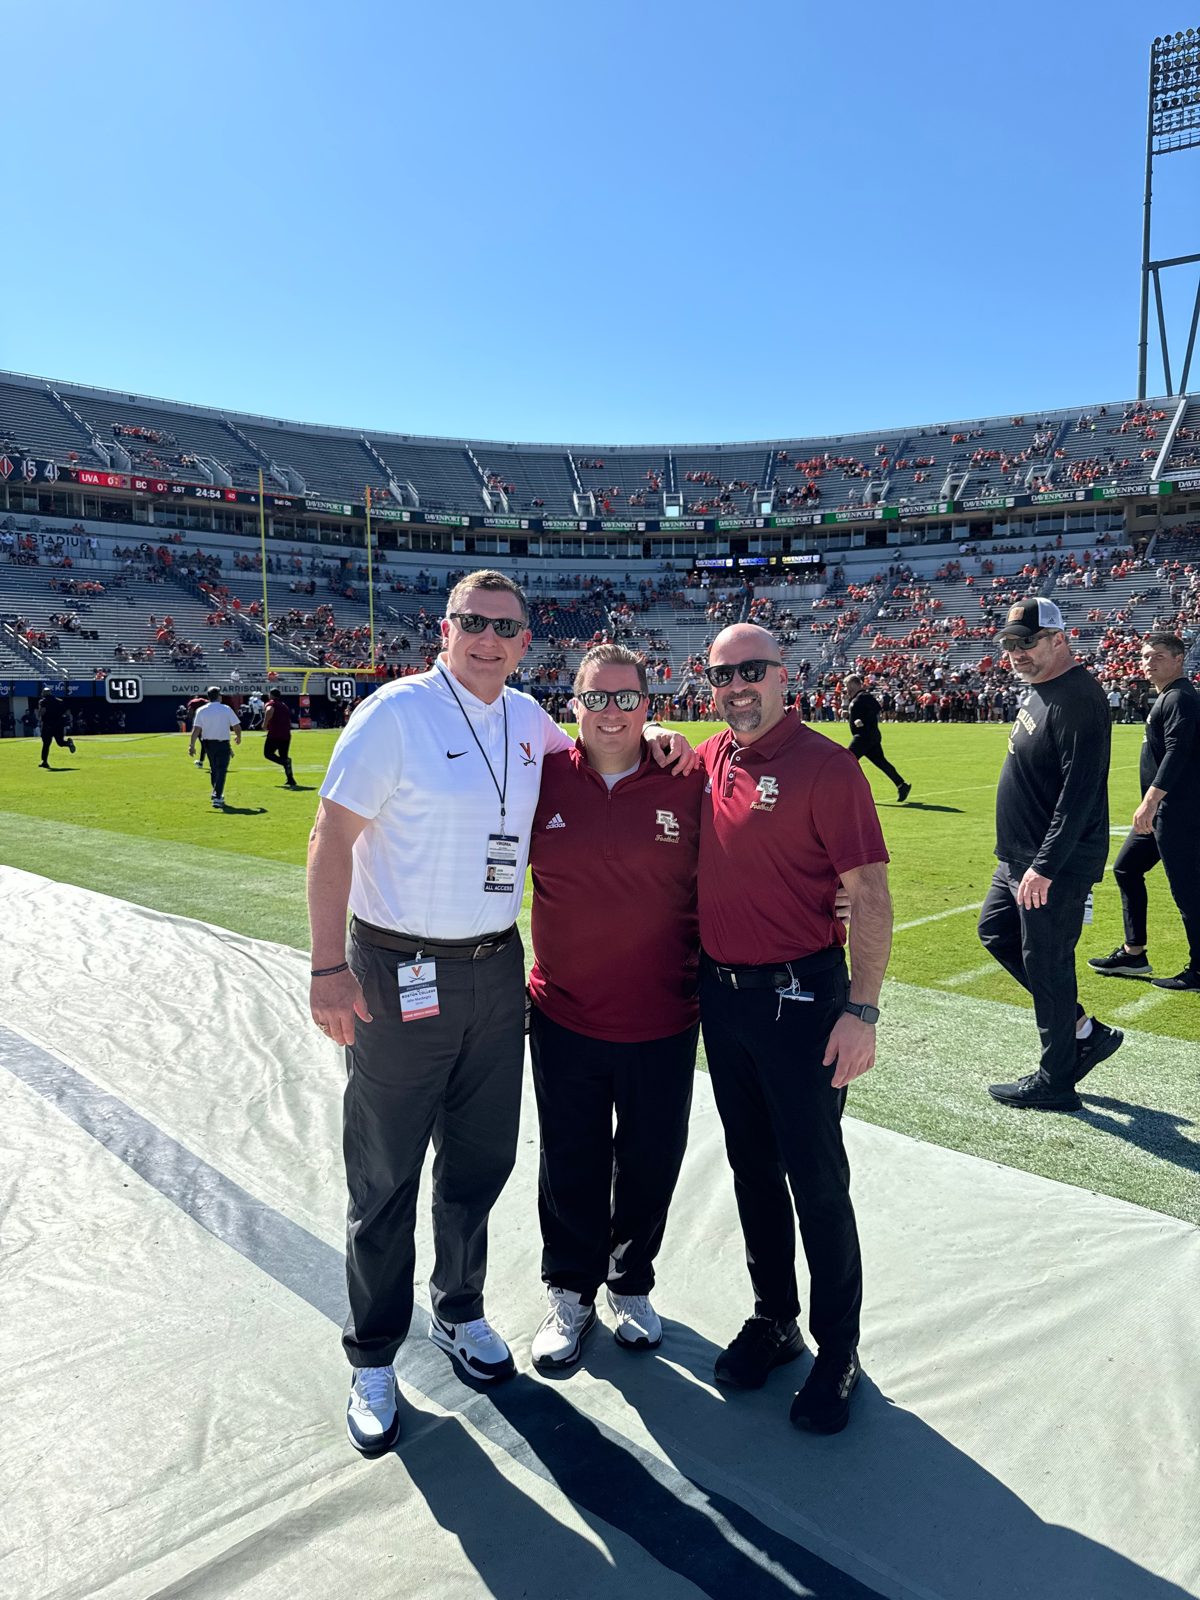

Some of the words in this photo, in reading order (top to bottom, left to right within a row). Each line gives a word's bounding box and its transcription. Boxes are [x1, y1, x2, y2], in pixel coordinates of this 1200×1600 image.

[23, 460, 37, 477] 15
[45, 463, 58, 480] 41
[81, 473, 99, 484] UVA
[107, 477, 113, 485] 0
[135, 481, 147, 489] BC
[1102, 484, 1148, 496] DAVENPORT
[195, 488, 221, 499] 24:54
[1031, 491, 1074, 502] DAVENPORT
[305, 500, 342, 510] DAVENPORT
[962, 498, 1005, 508] DAVENPORT
[366, 508, 401, 517] AVENPORT
[898, 504, 938, 514] DAVENPORT
[424, 513, 461, 522] DAVENPORT
[775, 515, 812, 525] DAVENPORT
[835, 510, 874, 520] DAVENPORT
[483, 517, 520, 526] DAVENPORT
[542, 520, 579, 528] DAVENPORT
[601, 521, 637, 529] DAVENPORT
[659, 520, 696, 529] DAVENPORT
[718, 519, 755, 527] DAVENPORT
[111, 680, 137, 699] 40
[172, 685, 200, 693] DAVID
[332, 681, 352, 698] 40
[750, 802, 776, 811] Football
[546, 822, 566, 830] adidas
[655, 835, 680, 843] Football
